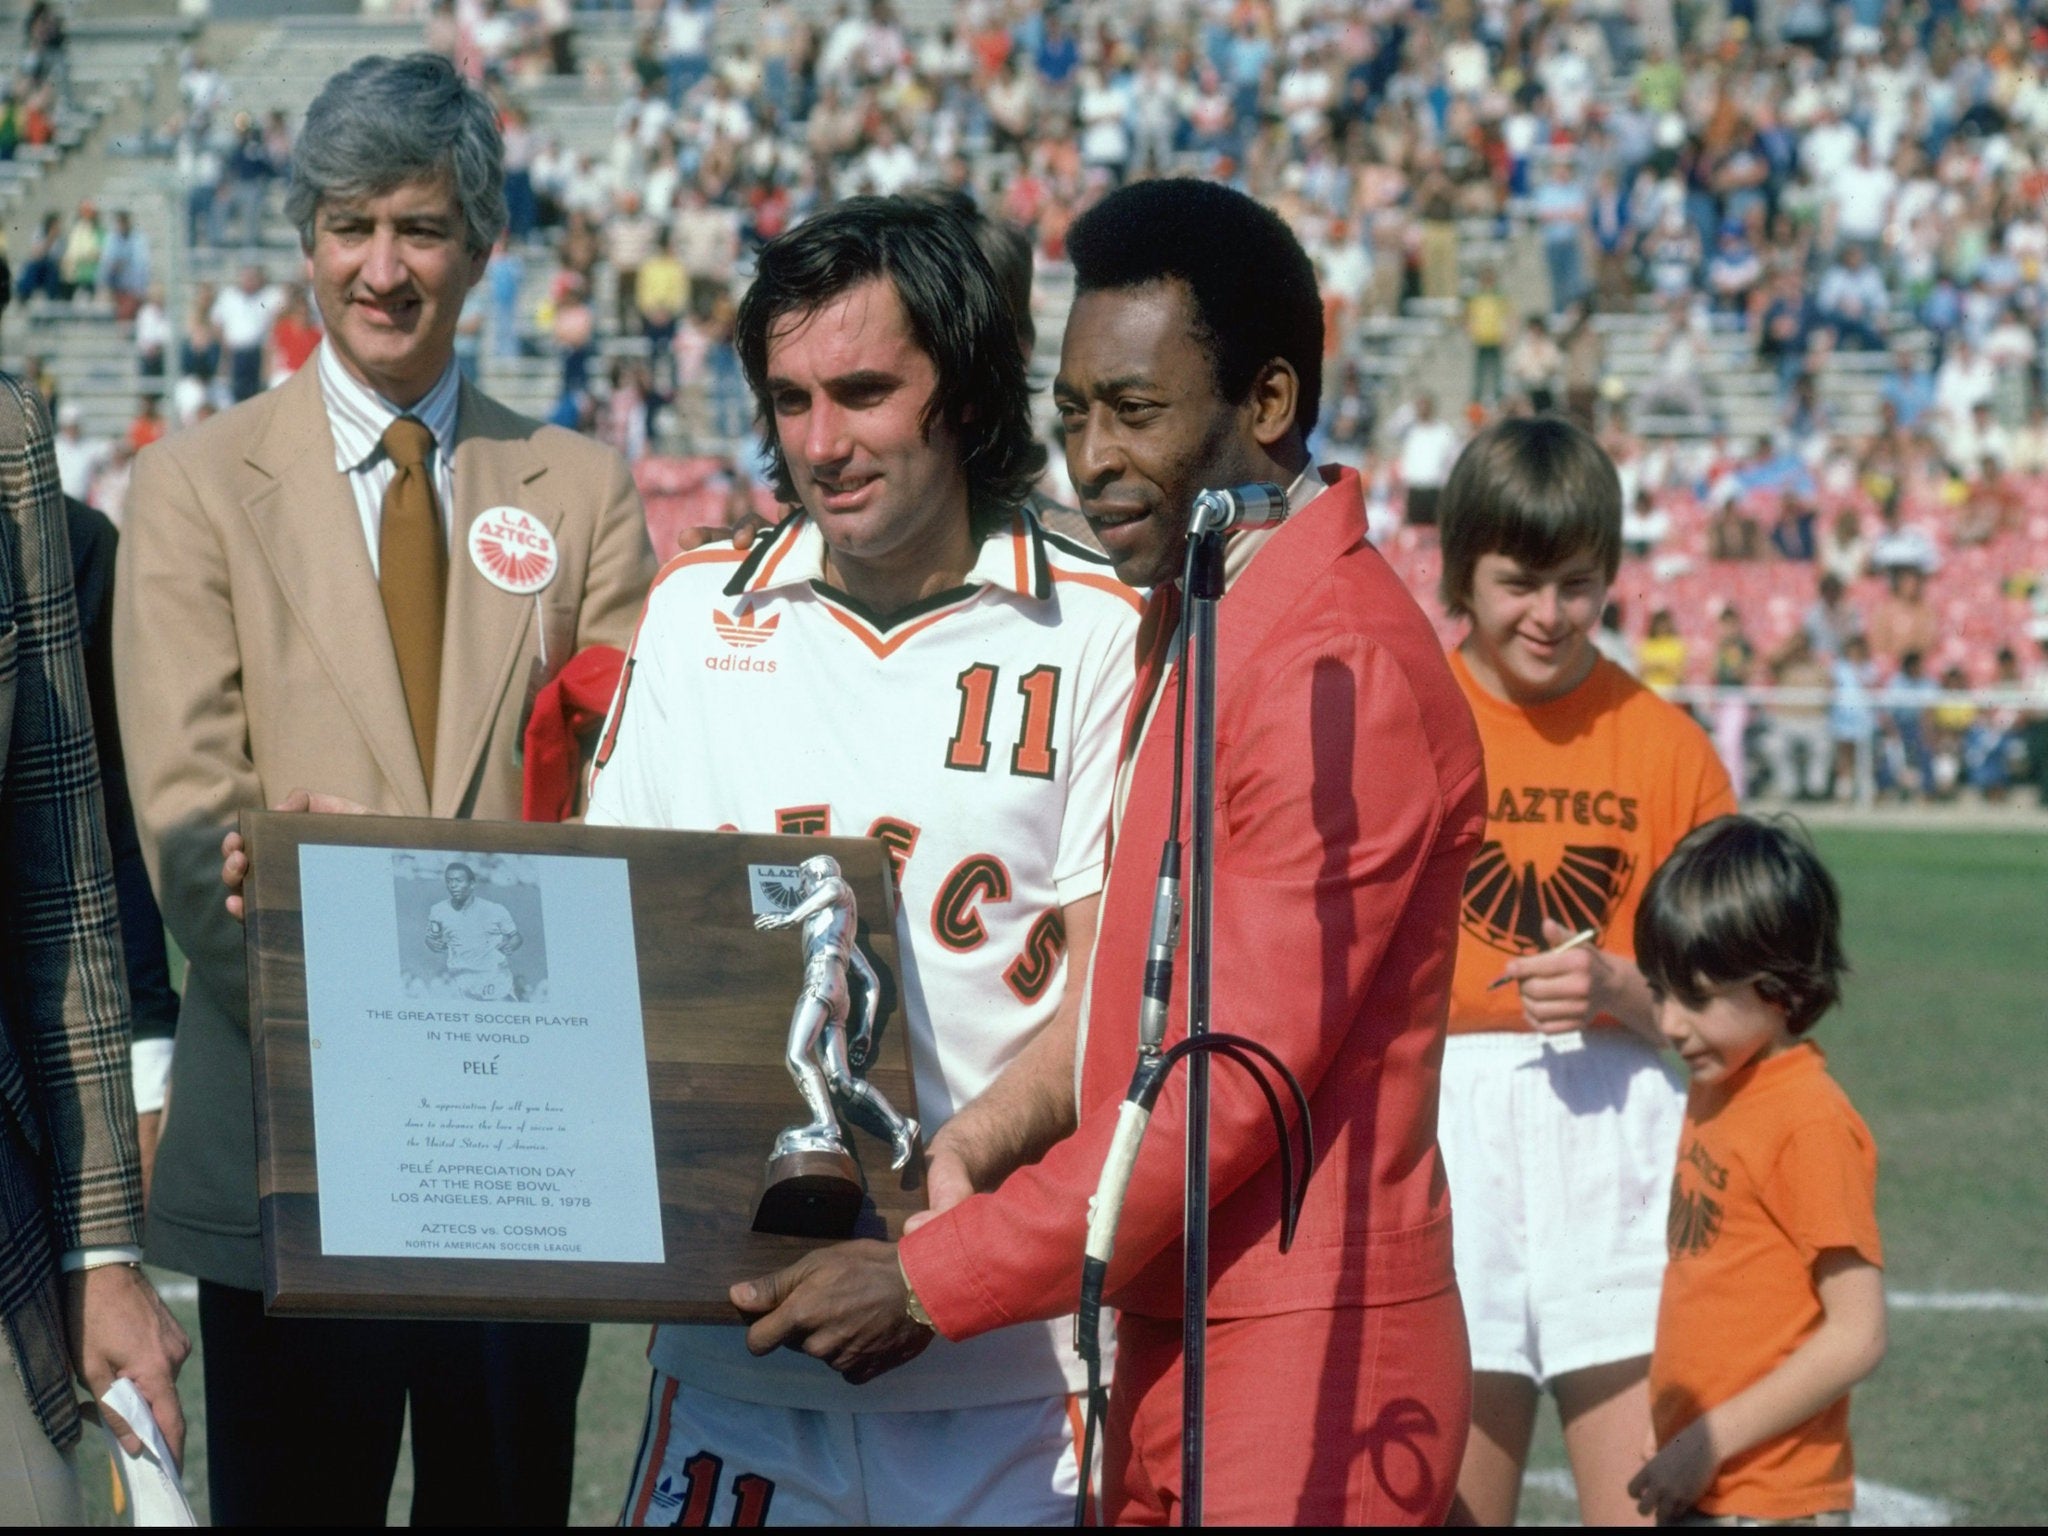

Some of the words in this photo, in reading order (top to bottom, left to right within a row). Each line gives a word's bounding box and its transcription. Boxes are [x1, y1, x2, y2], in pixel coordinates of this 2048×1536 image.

[480, 521, 549, 551] AZTECS
[705, 654, 777, 673] adidas
[944, 661, 1061, 780] 11
[1499, 786, 1638, 833] AZTECS
[366, 1009, 393, 1020] THE
[397, 1011, 469, 1023] GREATEST
[475, 1014, 531, 1025] SOCCER
[535, 1016, 589, 1027] PLAYER
[427, 1031, 441, 1041] IN
[445, 1032, 471, 1042] THE
[476, 1033, 530, 1044] WORLD
[463, 1054, 500, 1075] PELÉ
[417, 1098, 430, 1109] In
[435, 1102, 487, 1112] appreciation
[490, 1100, 504, 1112] for
[508, 1101, 522, 1111] all
[526, 1106, 540, 1114] you
[545, 1101, 564, 1112] have
[404, 1118, 424, 1128] done
[427, 1120, 436, 1128] to
[440, 1119, 474, 1129] advance
[478, 1120, 492, 1130] the
[516, 1120, 526, 1132] of
[406, 1137, 420, 1147] the
[425, 1136, 456, 1148] United
[459, 1138, 489, 1149] States
[493, 1139, 503, 1151] of
[400, 1160, 433, 1173] PELÉ
[437, 1164, 542, 1177] APPRECIATION
[546, 1167, 576, 1178] DAY
[419, 1179, 437, 1188] AT
[442, 1179, 469, 1189] THE
[474, 1180, 512, 1190] ROSE
[517, 1181, 560, 1192] BOWL
[391, 1192, 419, 1203] LOS
[496, 1196, 537, 1206] APRIL
[560, 1197, 591, 1208] 1978
[421, 1223, 477, 1235] AZTECS
[503, 1225, 567, 1237] COSMOS
[405, 1240, 440, 1249] NORTH
[444, 1241, 496, 1250] AMERICAN
[500, 1242, 540, 1251] SOCCER
[544, 1243, 582, 1253] LEAGUE
[670, 1450, 775, 1527] 11
